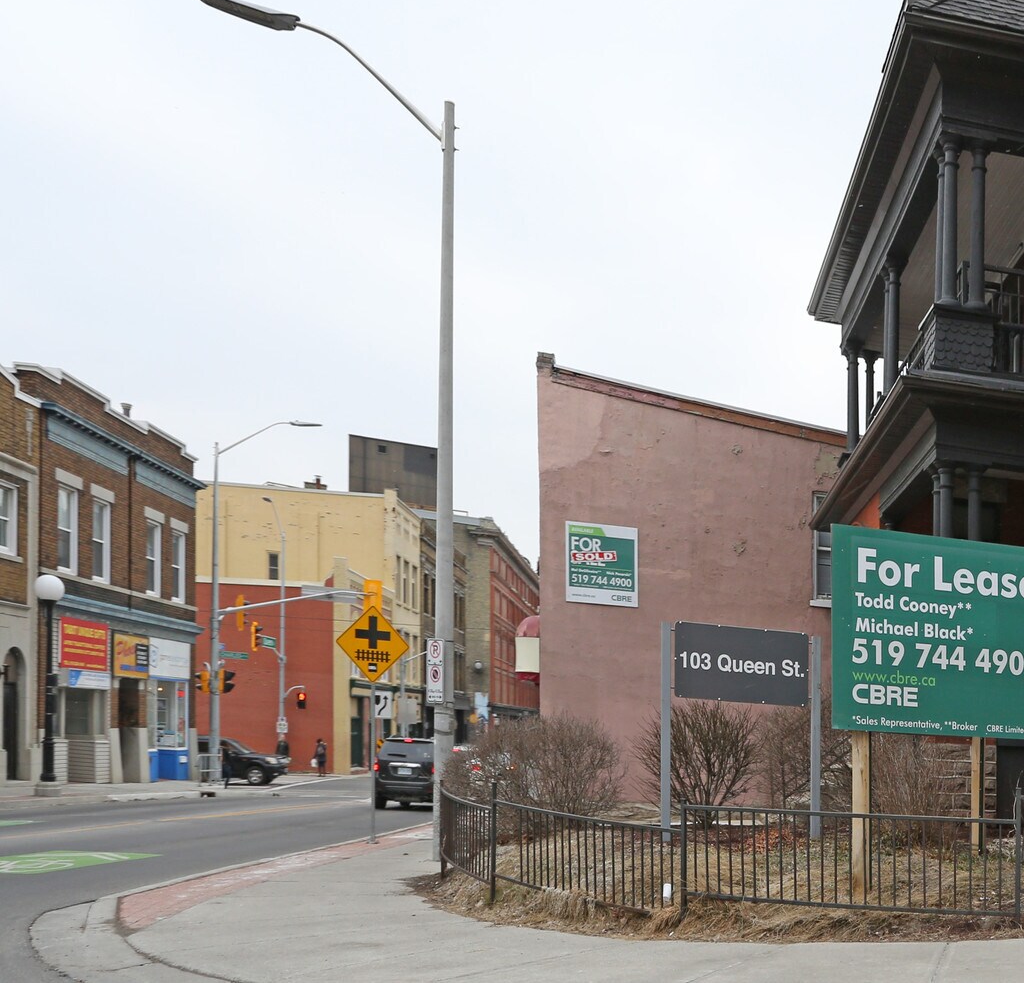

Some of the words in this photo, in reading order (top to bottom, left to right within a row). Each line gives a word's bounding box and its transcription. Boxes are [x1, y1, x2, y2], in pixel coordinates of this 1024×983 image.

[570, 536, 601, 552] FOR
[575, 552, 614, 561] SOLD
[857, 547, 920, 587] For
[571, 574, 589, 584] 519
[591, 575, 608, 586] 744
[609, 577, 632, 588] 4900
[611, 594, 632, 603] CBRE
[855, 592, 894, 610] Todd
[855, 617, 918, 637] Michael
[852, 638, 905, 666] 519
[915, 643, 966, 671] 744
[679, 651, 712, 671] 103
[717, 654, 776, 676] Queen
[781, 659, 805, 678] St.
[852, 670, 936, 687] www.cbre.ca
[852, 683, 919, 708] CBRE
[880, 716, 943, 731] Representative,
[986, 724, 1003, 733] CBRE
